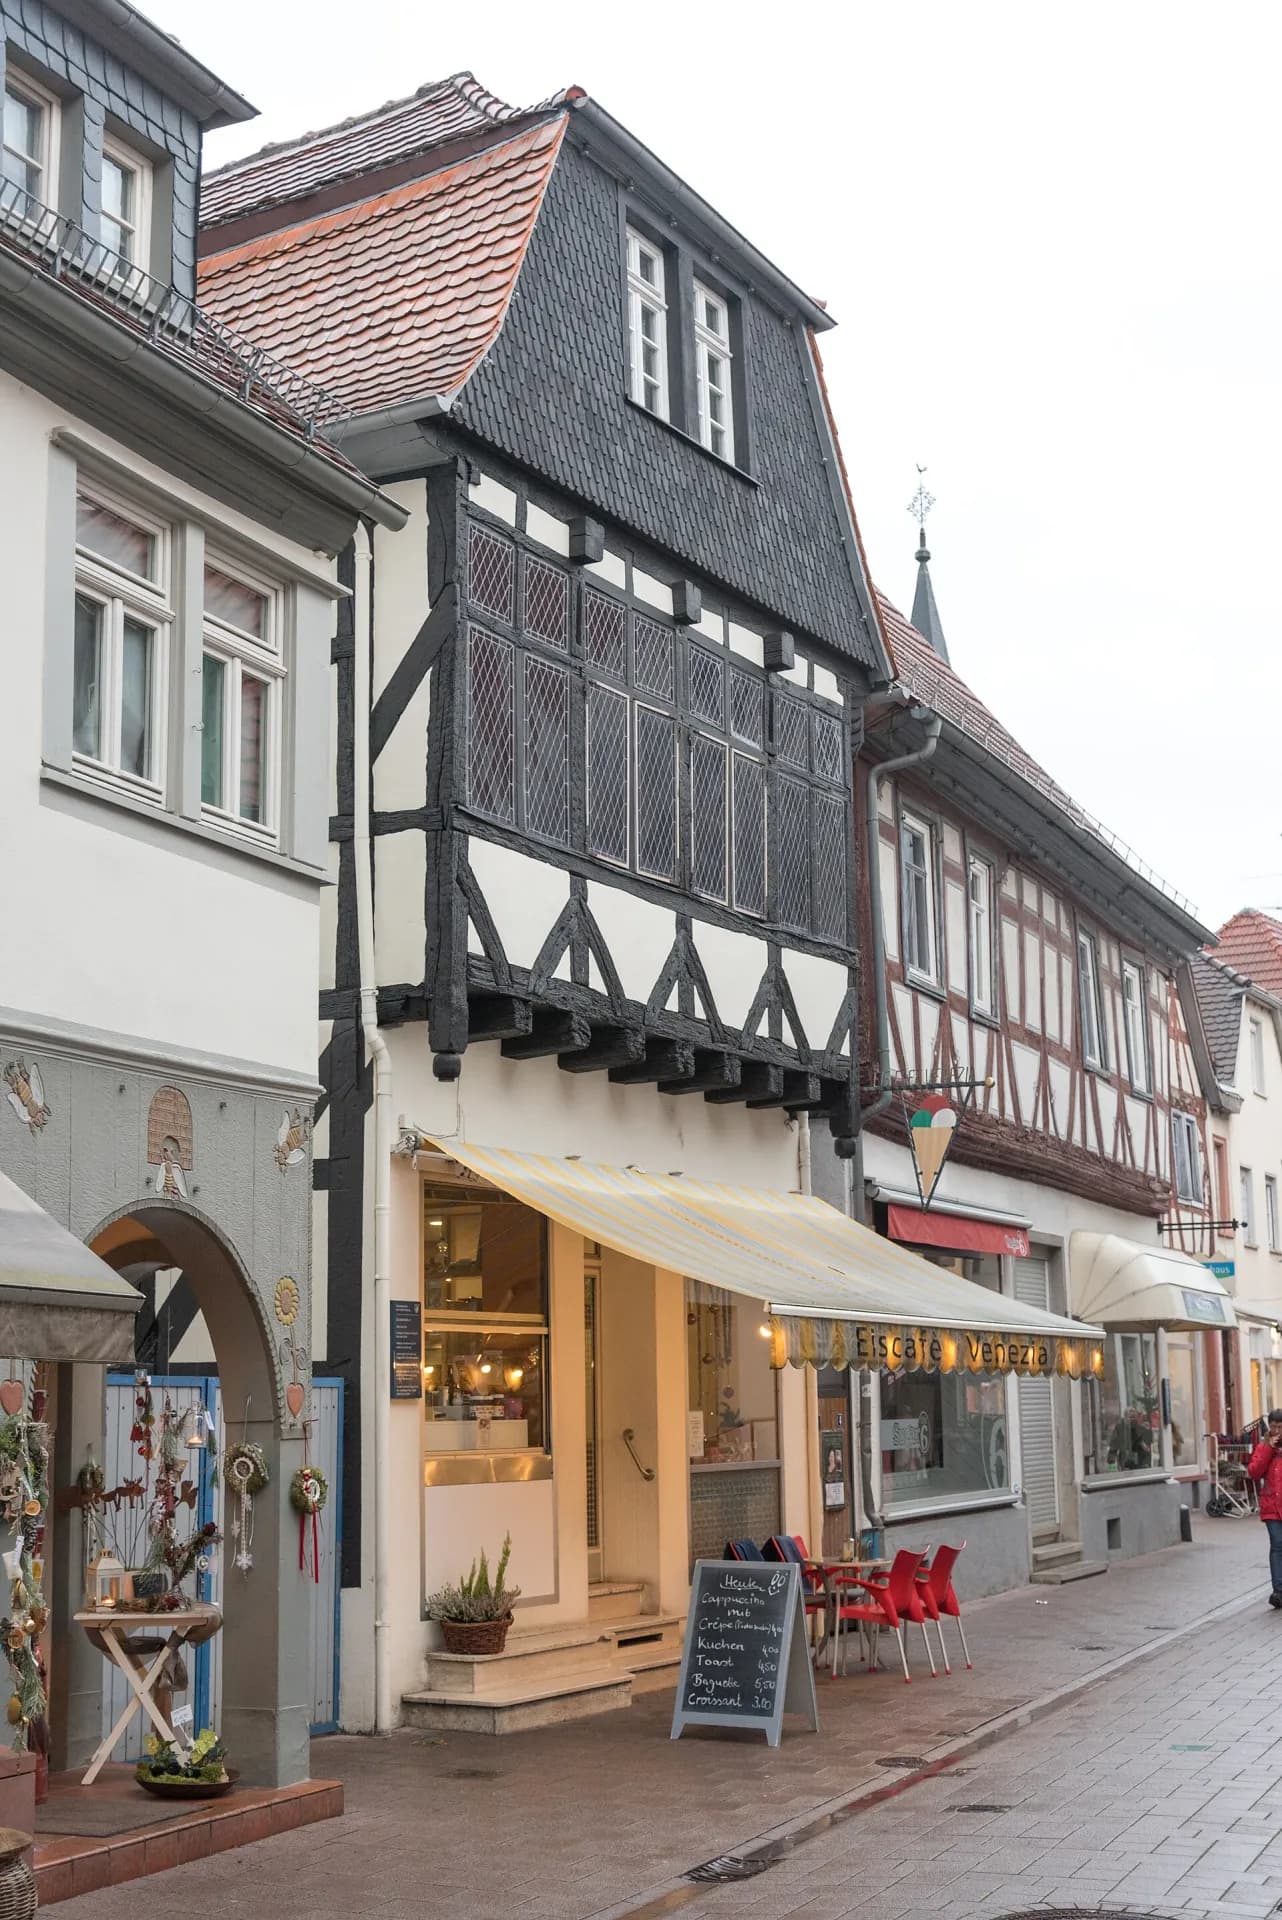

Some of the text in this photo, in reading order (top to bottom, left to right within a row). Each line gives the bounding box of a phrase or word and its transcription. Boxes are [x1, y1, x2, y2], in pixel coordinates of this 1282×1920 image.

[966, 1335, 1048, 1365] Venezia
[724, 1573, 760, 1589] Heute
[702, 1592, 765, 1606] Cappuccino
[727, 1608, 751, 1617] mit
[697, 1636, 744, 1651] Kuchen
[696, 1654, 777, 1673] Toast 4,50
[691, 1673, 776, 1693] Baguette 5,50
[688, 1693, 742, 1707] Croissant
